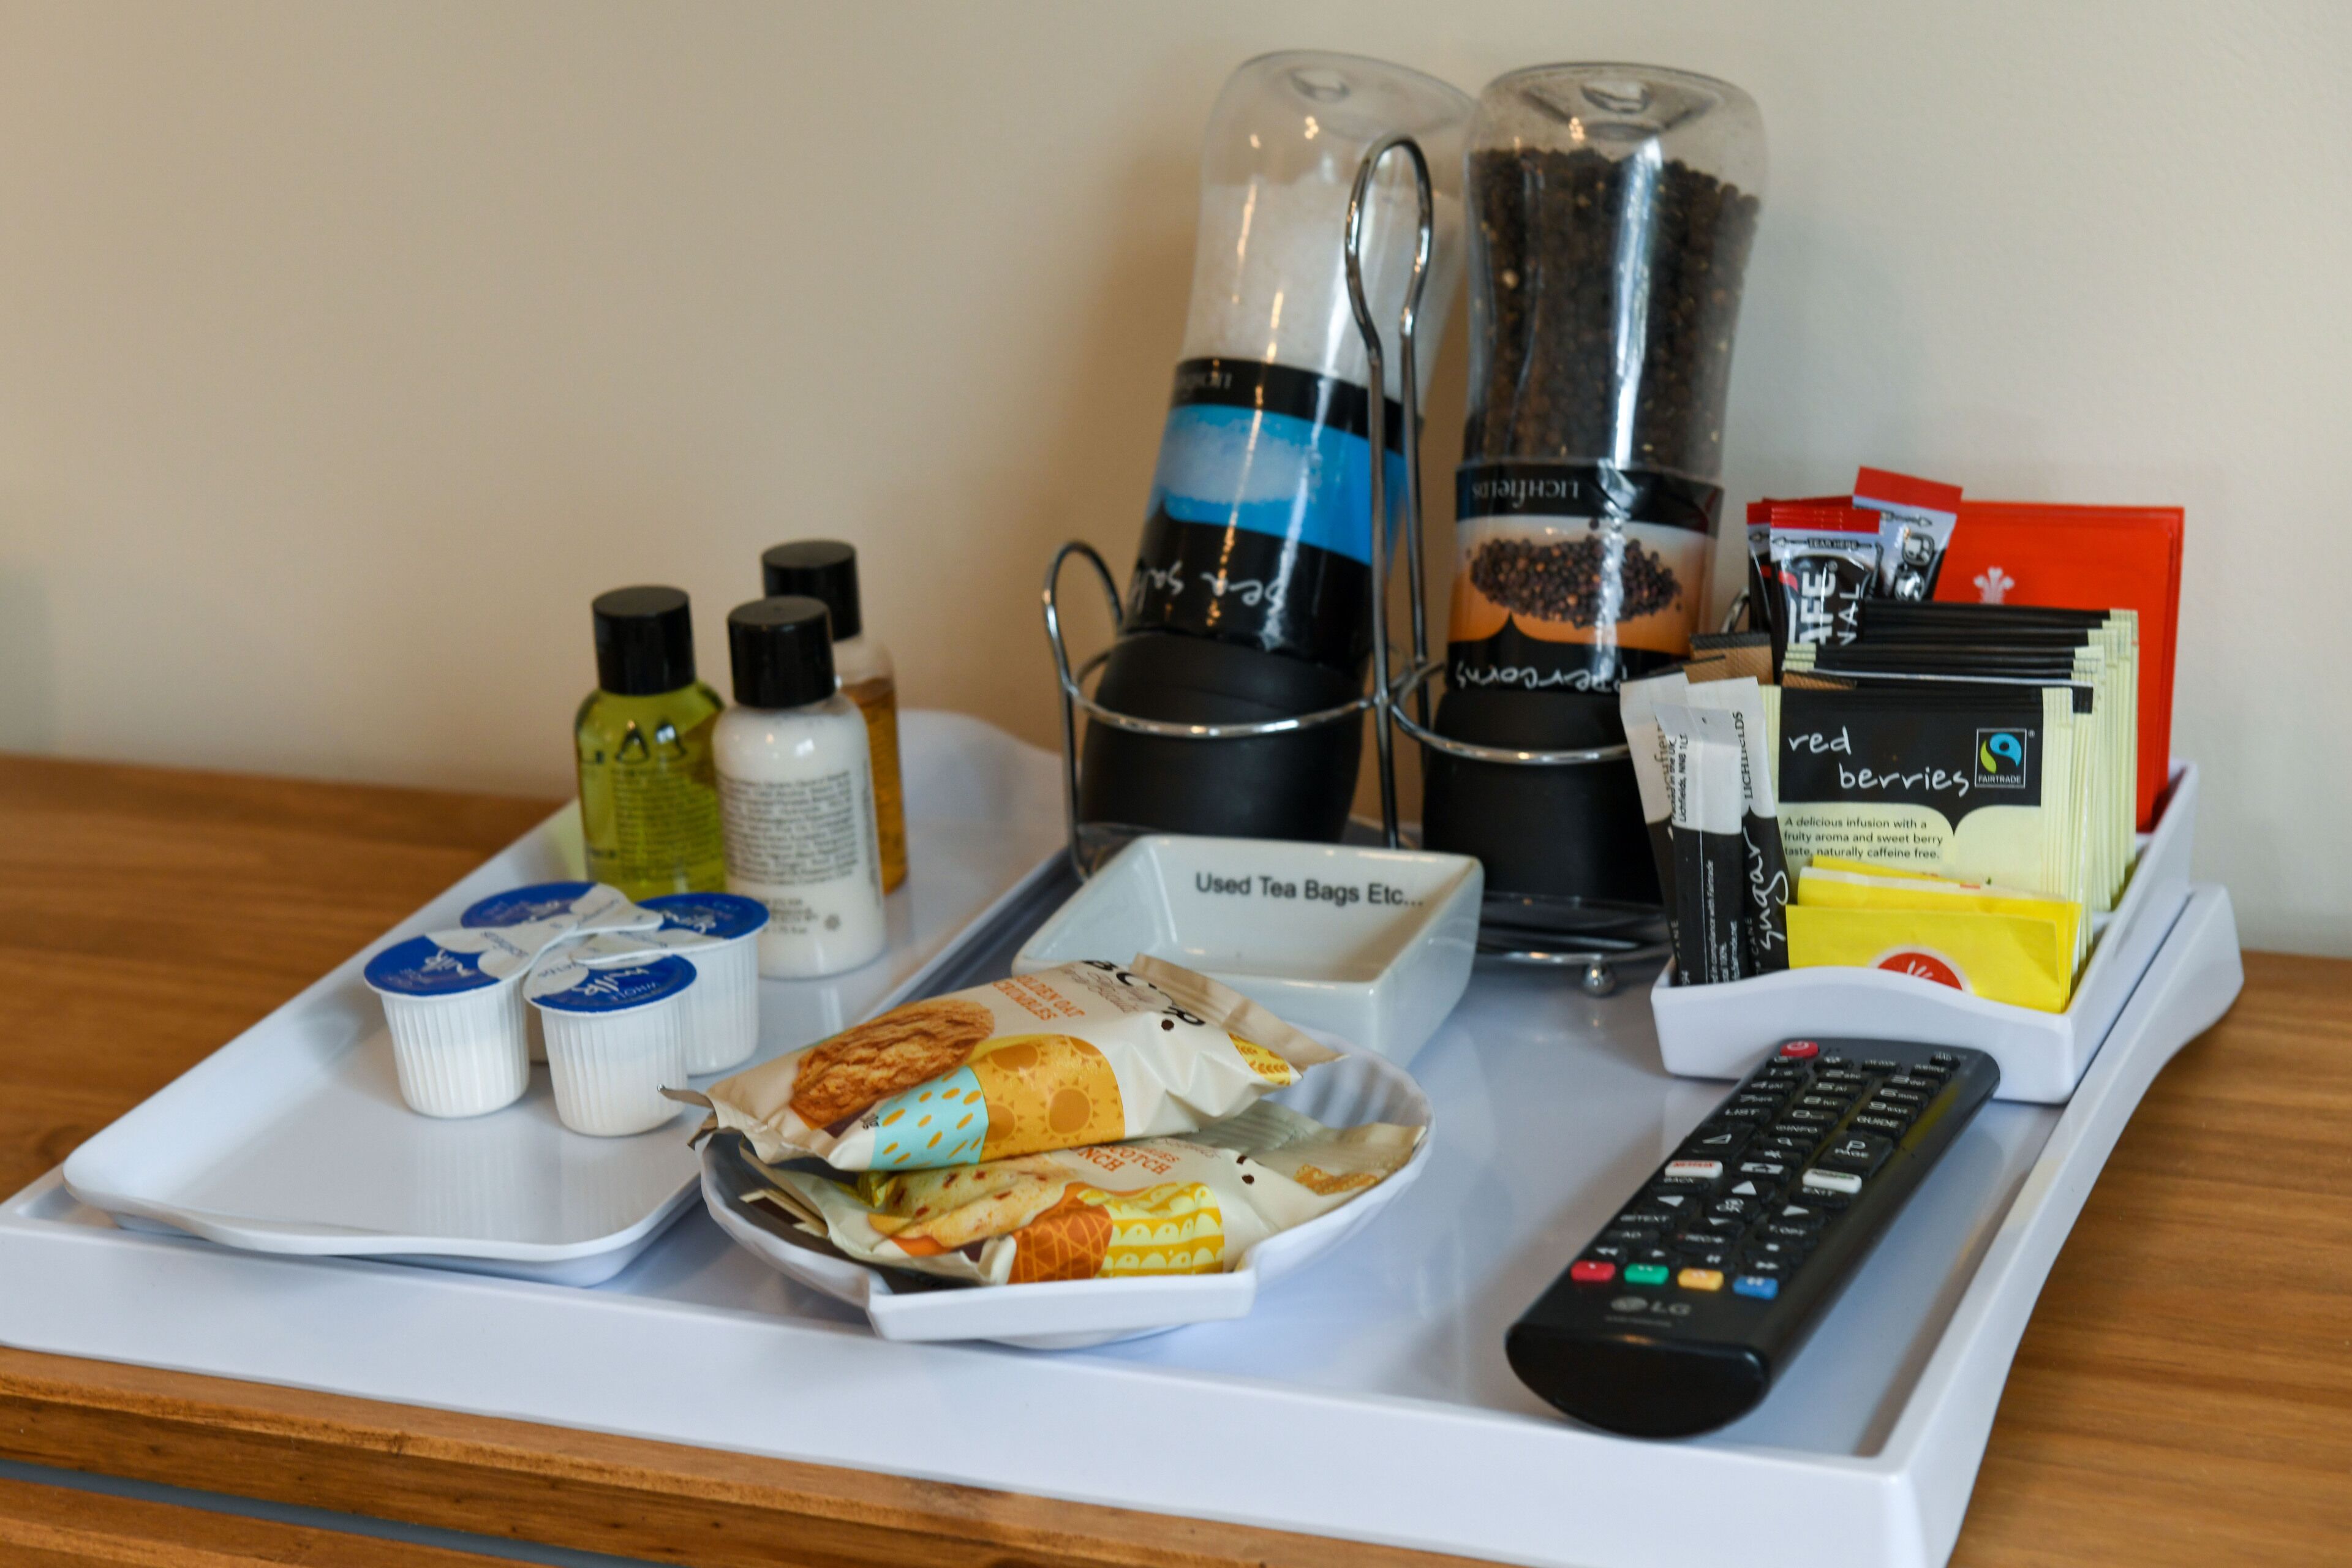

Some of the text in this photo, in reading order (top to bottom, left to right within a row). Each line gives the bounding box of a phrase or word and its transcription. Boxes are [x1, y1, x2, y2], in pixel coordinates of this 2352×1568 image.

[1837, 583, 1861, 646] NAL
[1788, 725, 1853, 755] red
[1838, 763, 1970, 798] berries
[1978, 774, 2022, 785] FAIRTRADE
[1784, 816, 1793, 826] A
[1796, 817, 1843, 827] delicious
[1846, 817, 1890, 828] infusion
[1893, 818, 1917, 829] with
[1784, 831, 1943, 846] fruity aroma and sweet berry
[1817, 846, 1864, 860] naturally
[1867, 846, 1911, 858] caffeine
[1914, 847, 1940, 859] free.
[1196, 872, 1251, 895] Used
[1258, 876, 1297, 899] Tea
[1304, 879, 1360, 907] Bags
[1743, 826, 1789, 951] sugar
[1724, 1107, 1760, 1117] LIST
[1856, 1115, 1899, 1129] GUIDE
[1651, 1300, 1692, 1316] LG
